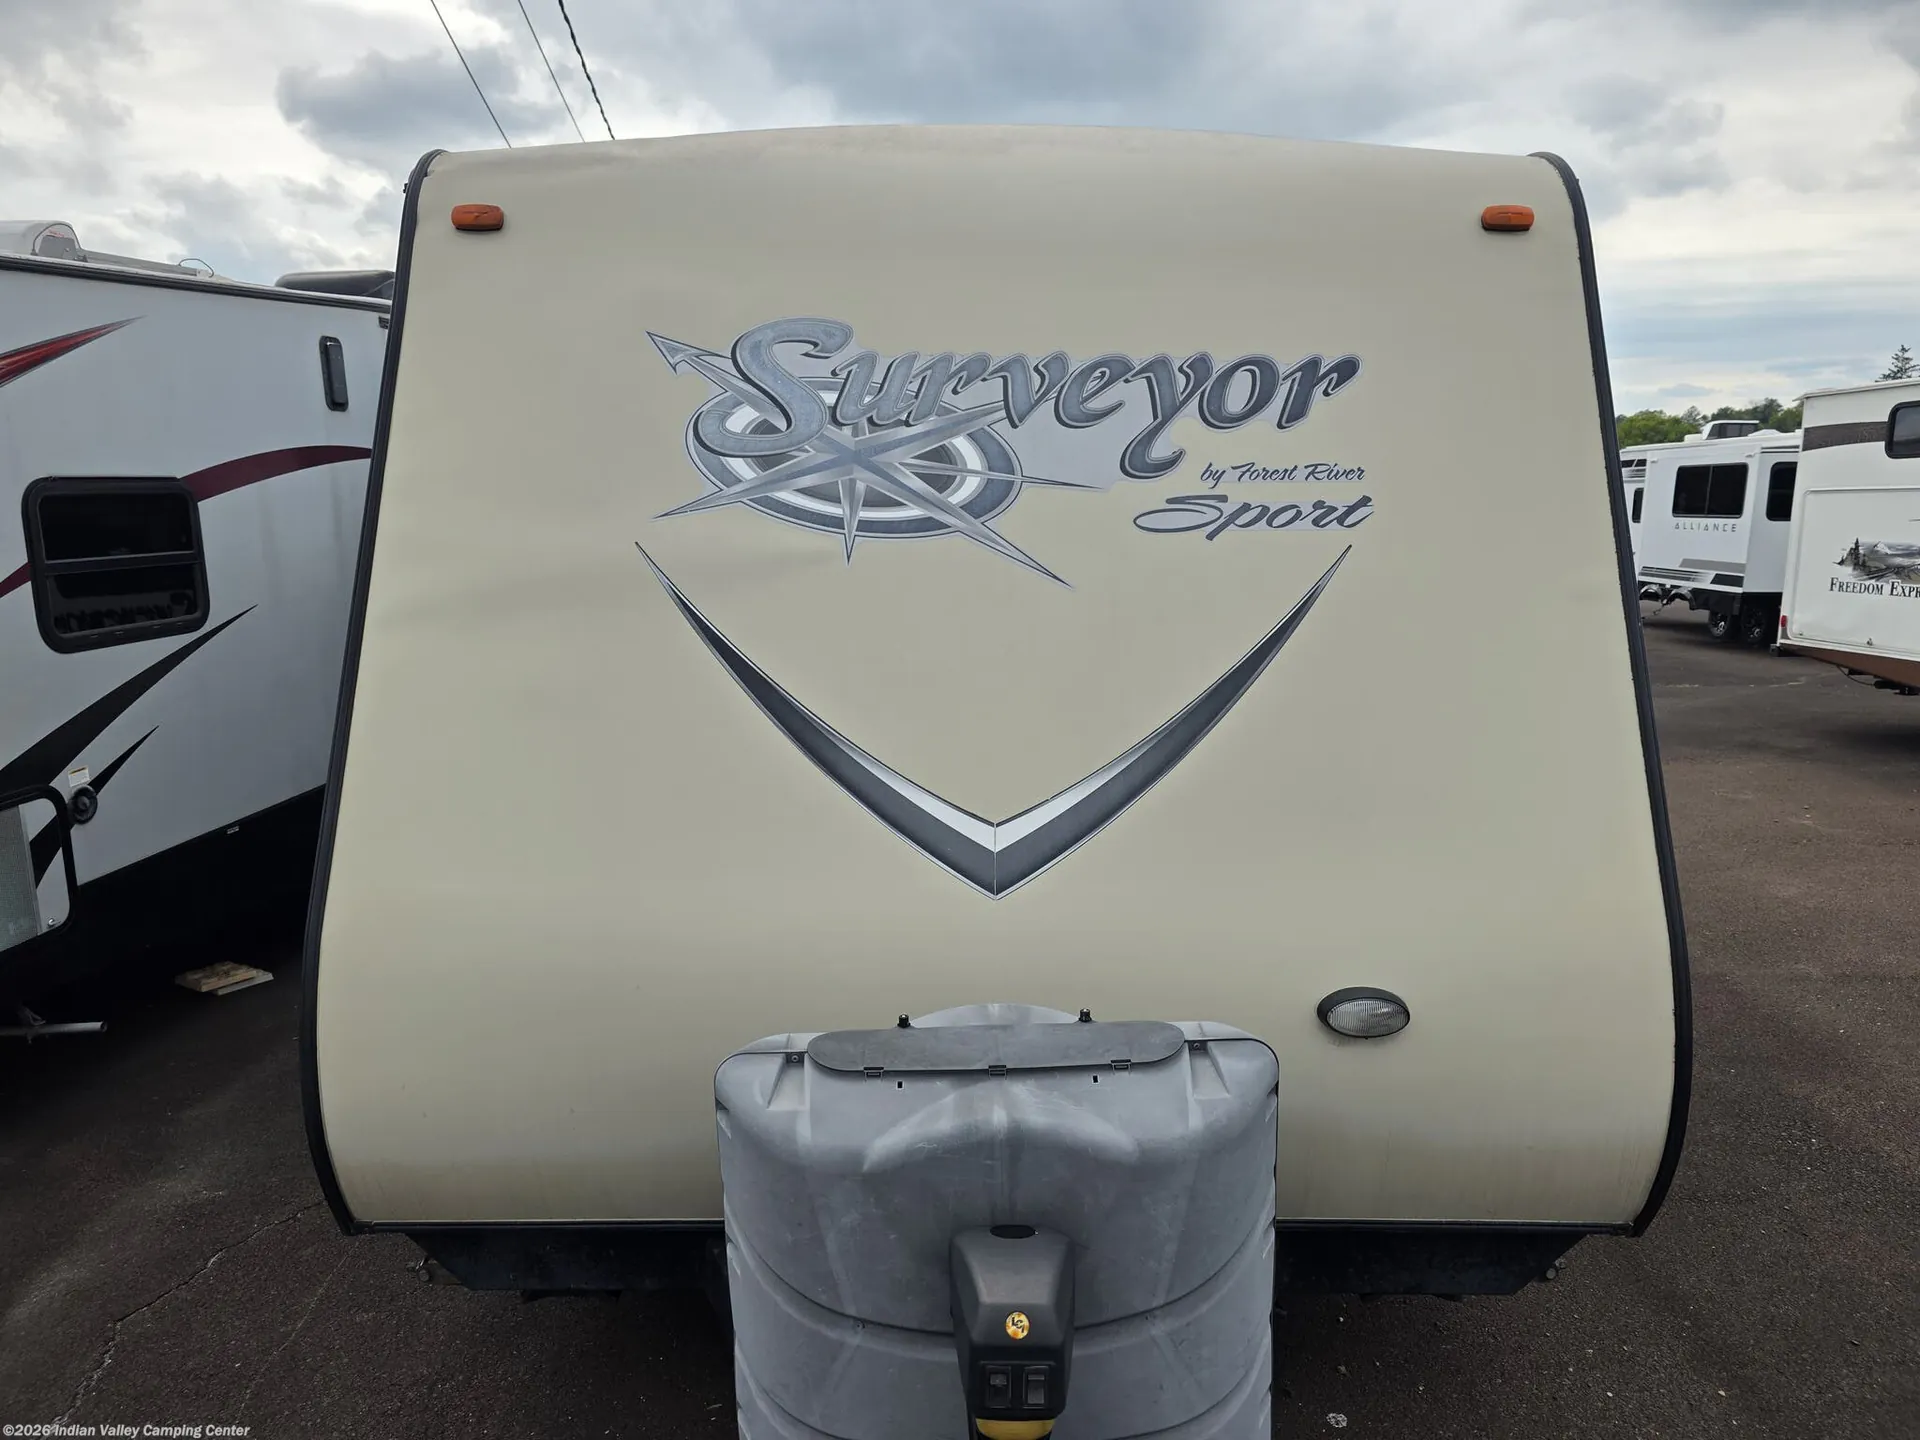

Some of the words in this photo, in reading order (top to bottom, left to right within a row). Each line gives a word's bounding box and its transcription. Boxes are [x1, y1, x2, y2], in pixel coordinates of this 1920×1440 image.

[691, 317, 1361, 478] Surveyor
[1200, 462, 1226, 489] by
[1231, 461, 1298, 482] Forest
[1304, 463, 1365, 481] River
[1133, 494, 1374, 541] Sport
[1674, 522, 1737, 532] ALLIANCE
[1829, 577, 1884, 595] FREEDOM
